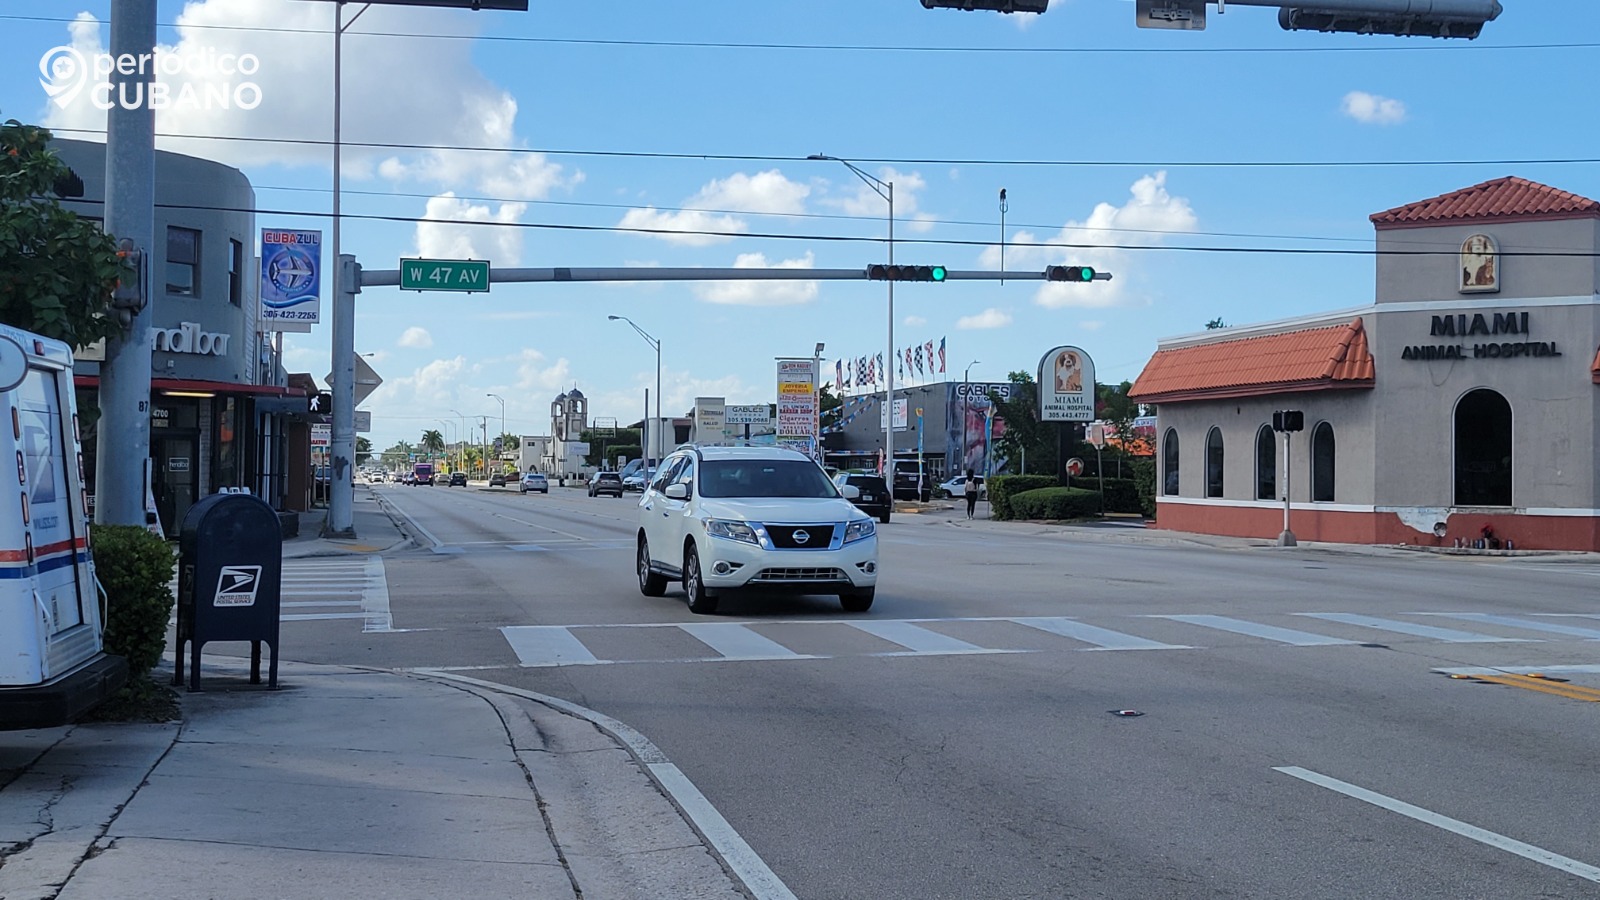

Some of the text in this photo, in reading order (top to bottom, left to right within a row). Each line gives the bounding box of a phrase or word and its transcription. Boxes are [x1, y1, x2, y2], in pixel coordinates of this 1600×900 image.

[265, 232, 318, 245] CUBAZUL
[410, 267, 480, 284] W 47 AV
[263, 310, 317, 320] 305-423-2255
[1430, 312, 1529, 337] MIAMI
[1401, 341, 1563, 360] ANIMAL HOSPITAL
[1054, 396, 1083, 404] MIAMI
[138, 401, 149, 413] 87
[152, 409, 169, 418] 4700
